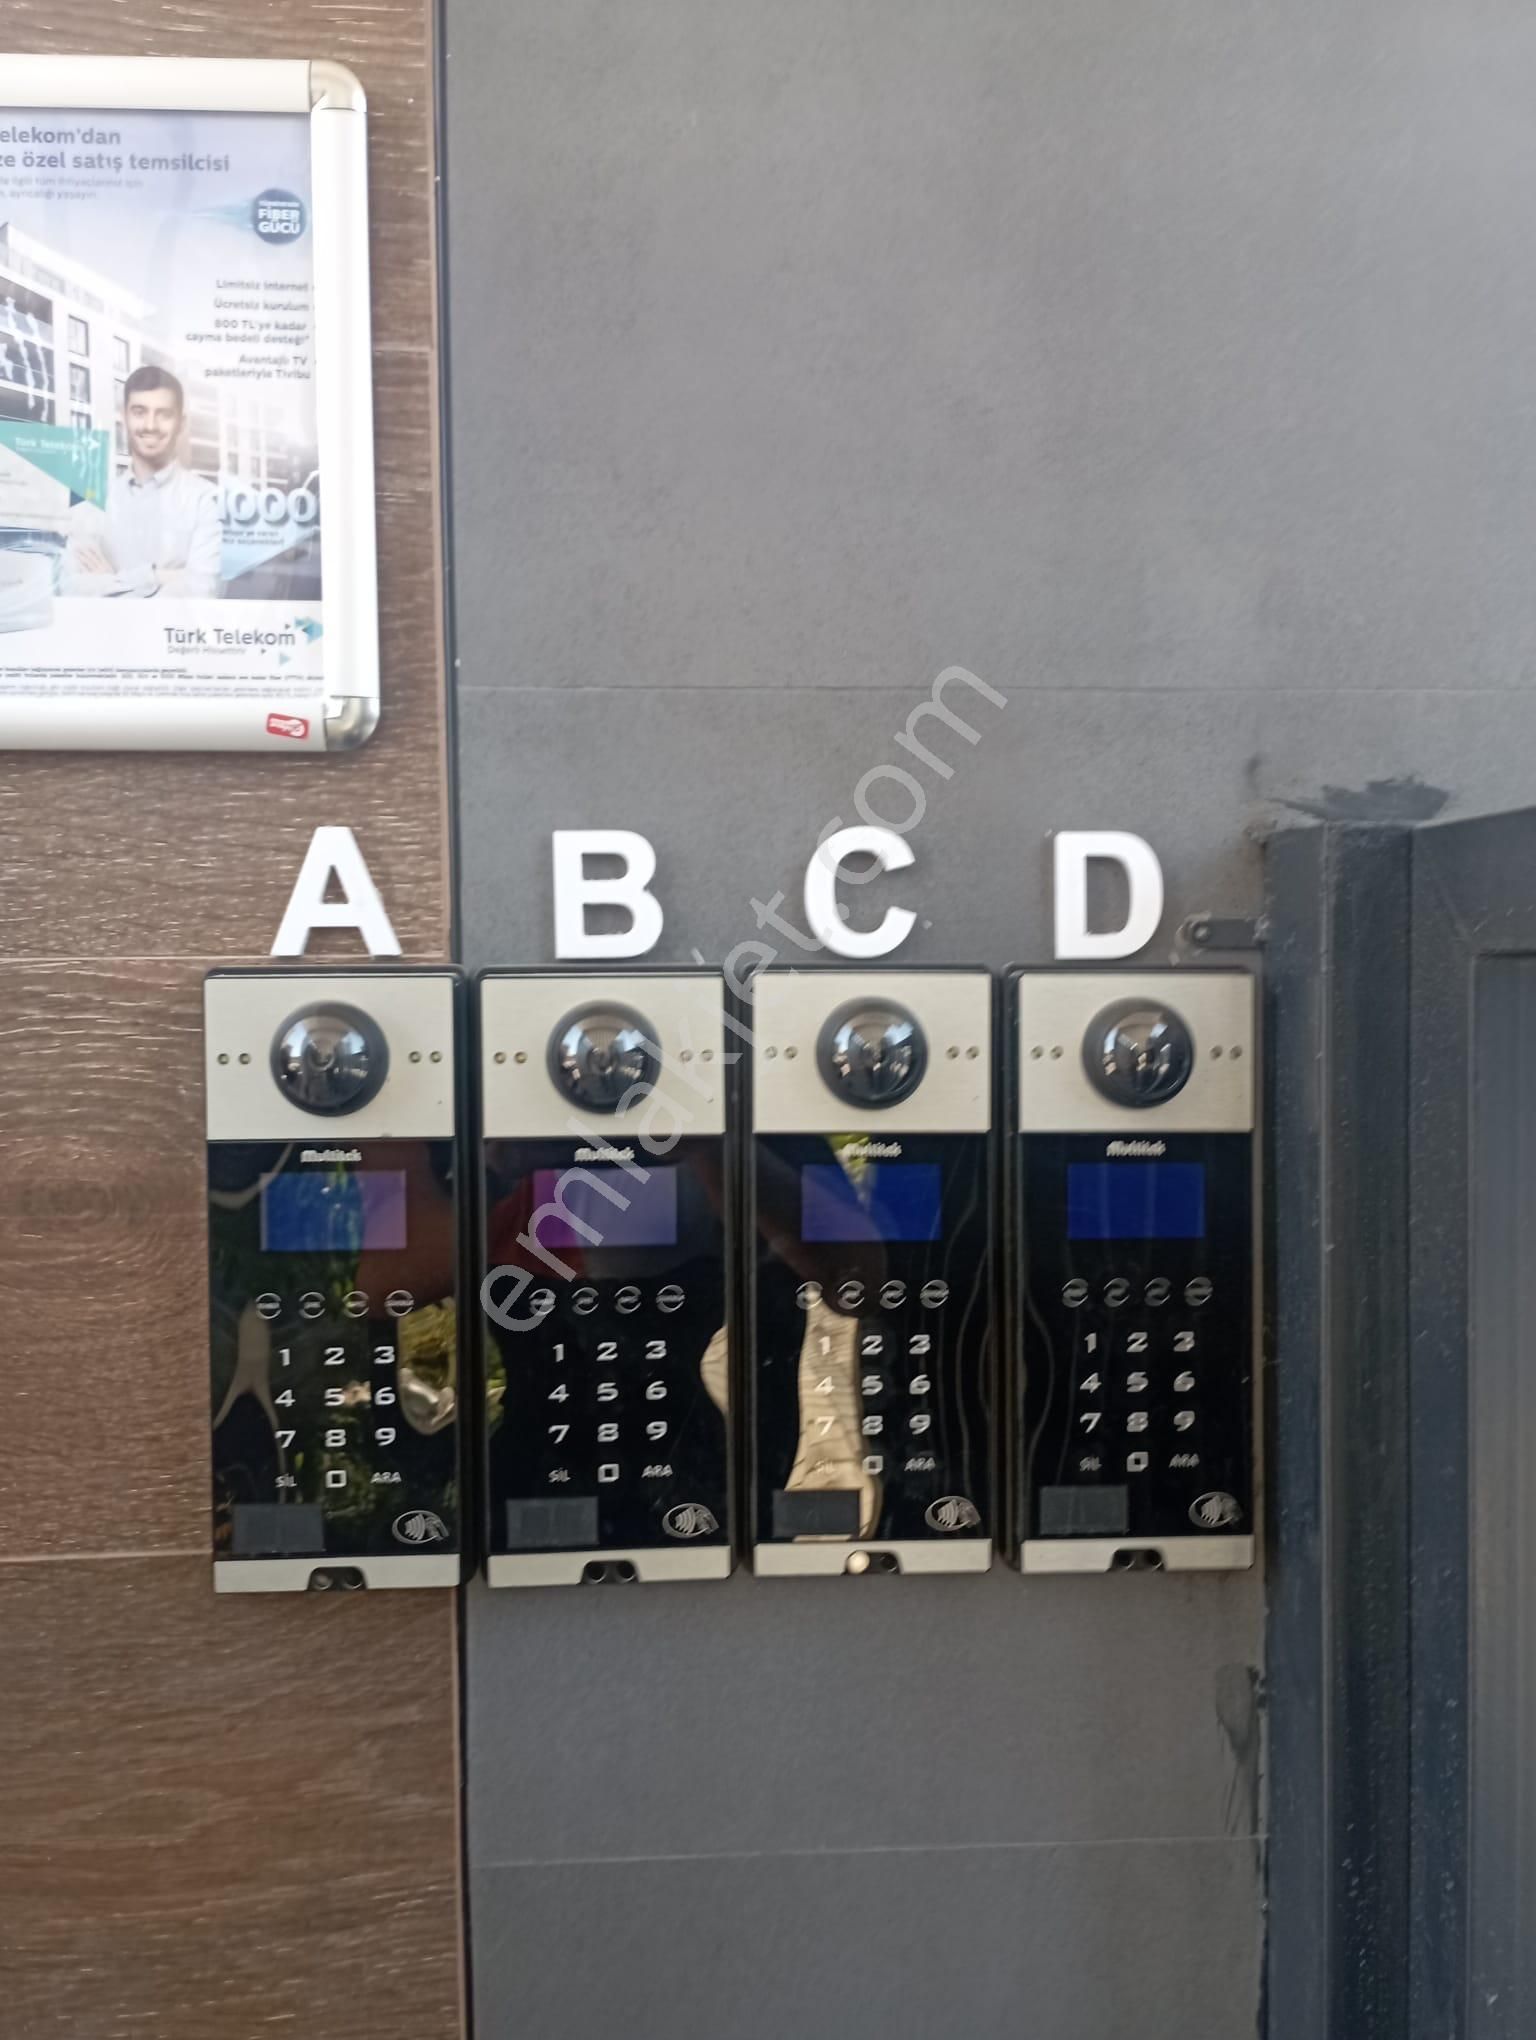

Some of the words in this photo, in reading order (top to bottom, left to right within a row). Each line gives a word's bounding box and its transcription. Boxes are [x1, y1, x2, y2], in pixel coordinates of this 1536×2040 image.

[22, 151, 67, 169] özel
[72, 153, 123, 172] satış
[129, 153, 230, 172] temsilcisi
[292, 356, 308, 365] TV
[164, 627, 208, 644] Türk
[213, 628, 296, 646] Telekom
[271, 826, 404, 957] A
[551, 830, 664, 959] B
[803, 825, 917, 959] C
[1056, 832, 1161, 957] D
[553, 1343, 564, 1362] 1
[596, 1342, 618, 1361] 2
[645, 1340, 667, 1359] 3
[818, 1336, 830, 1355] 1
[862, 1335, 883, 1355] 2
[909, 1334, 930, 1354] 3
[1084, 1332, 1097, 1353] 1
[1127, 1332, 1148, 1352] 2
[279, 1348, 290, 1366] 1
[324, 1347, 346, 1365] 2
[374, 1346, 395, 1364] 3
[548, 1384, 570, 1403] 4
[597, 1382, 618, 1401] 5
[645, 1381, 667, 1400] 6
[814, 1376, 835, 1395] 4
[862, 1375, 883, 1395] 5
[909, 1374, 931, 1395] 6
[1080, 1372, 1102, 1393] 4
[1127, 1371, 1148, 1392] 5
[1174, 1371, 1195, 1392] 6
[275, 1389, 296, 1407] 4
[324, 1388, 345, 1406] 5
[374, 1387, 396, 1405] 6
[548, 1425, 570, 1443] 7
[597, 1423, 619, 1442] 8
[646, 1421, 668, 1440] 9
[815, 1416, 836, 1436] 7
[862, 1415, 883, 1435] 8
[909, 1415, 931, 1434] 9
[1080, 1412, 1102, 1433] 7
[1174, 1410, 1195, 1431] 9
[275, 1430, 296, 1448] 7
[325, 1429, 346, 1447] 8
[375, 1427, 396, 1446] 9
[863, 1456, 883, 1475] 0
[905, 1458, 936, 1472] ARA
[1127, 1451, 1148, 1472] 0
[326, 1470, 347, 1488] 0
[370, 1471, 402, 1484] ARA
[597, 1464, 619, 1483] 0
[641, 1464, 673, 1478] ARA
